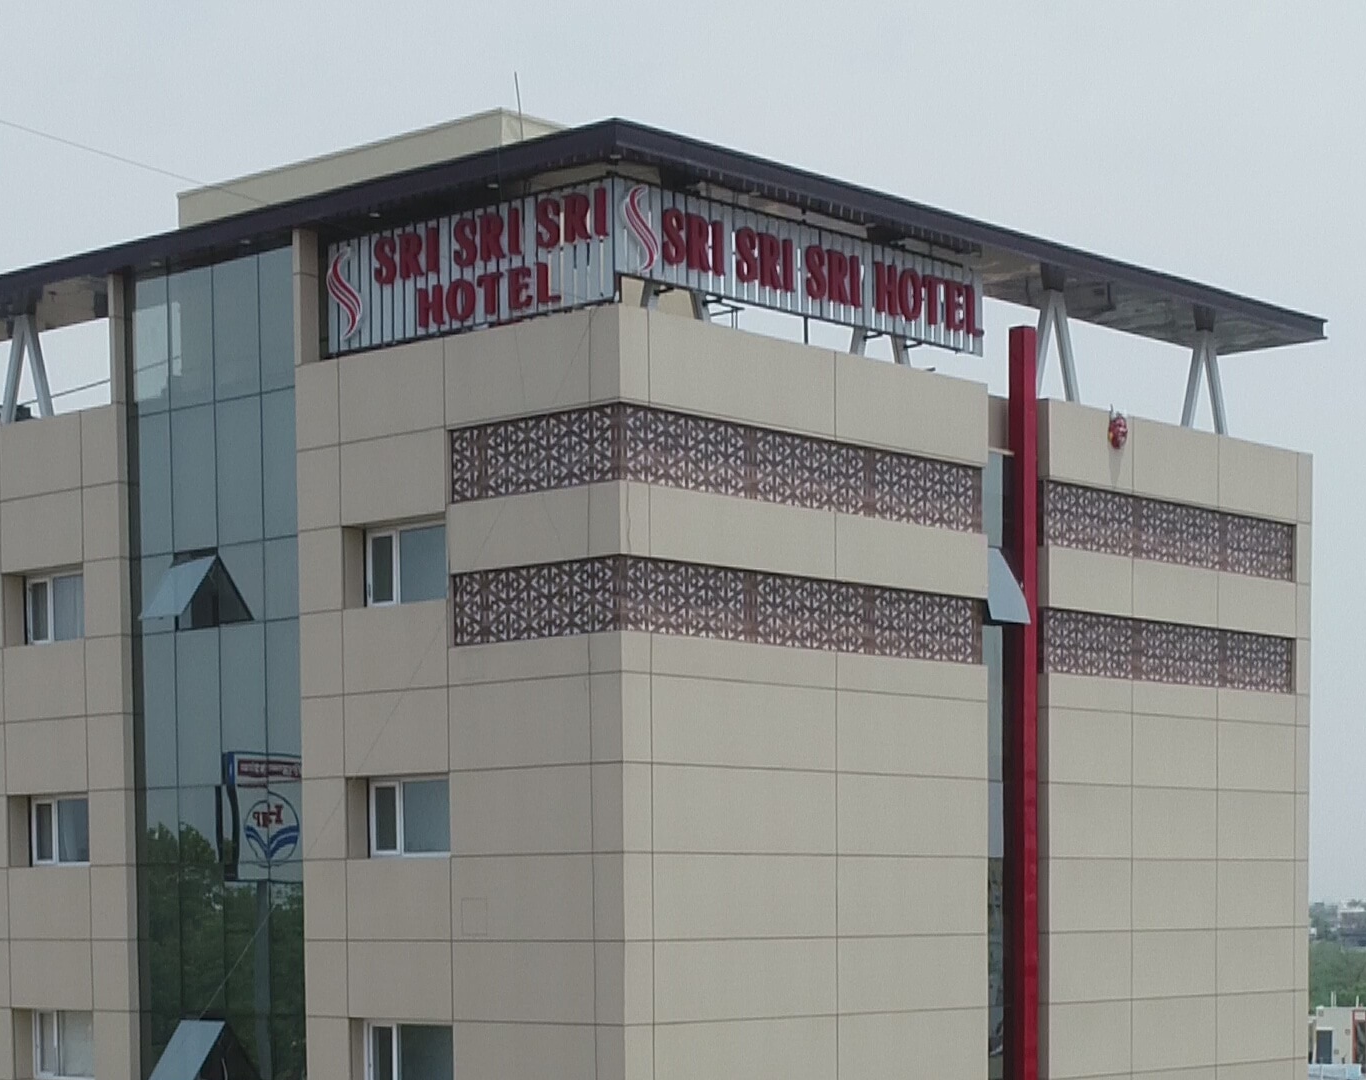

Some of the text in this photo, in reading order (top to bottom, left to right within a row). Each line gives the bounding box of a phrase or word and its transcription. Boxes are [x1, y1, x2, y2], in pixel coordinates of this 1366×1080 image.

[374, 187, 609, 286] SRI SRI SRI
[662, 207, 985, 338] SRI SRI SRI HOTEL
[418, 262, 562, 329] HOTEL
